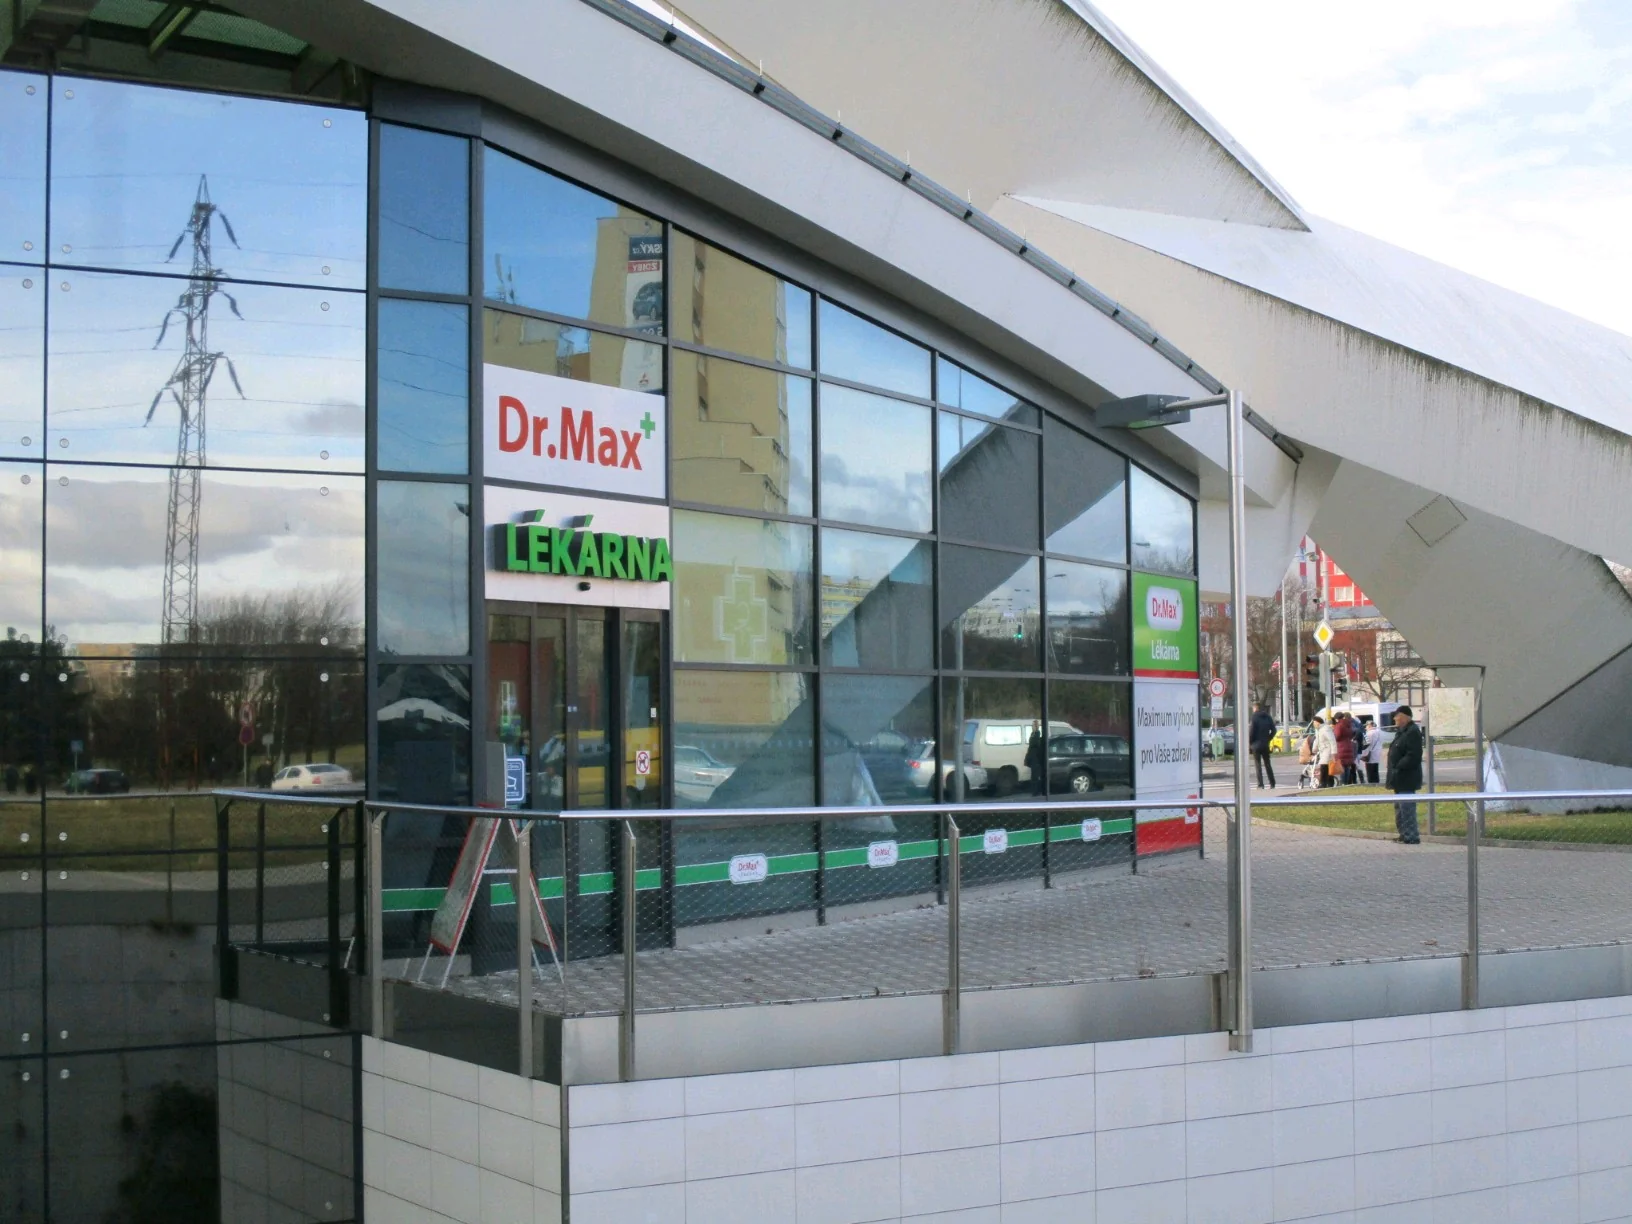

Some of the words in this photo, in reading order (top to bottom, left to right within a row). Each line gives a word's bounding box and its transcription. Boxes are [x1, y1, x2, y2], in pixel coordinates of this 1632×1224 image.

[498, 395, 643, 471] Dr.Max
[507, 508, 674, 582] LÉKÁRNA
[1152, 597, 1177, 620] Dr.Max
[1151, 639, 1180, 661] Lékárna
[1137, 706, 1172, 728] Maximum
[1173, 704, 1195, 732] výhod
[1141, 749, 1154, 770] pro
[1154, 743, 1171, 763] Vaše
[1171, 741, 1193, 763] zdraví
